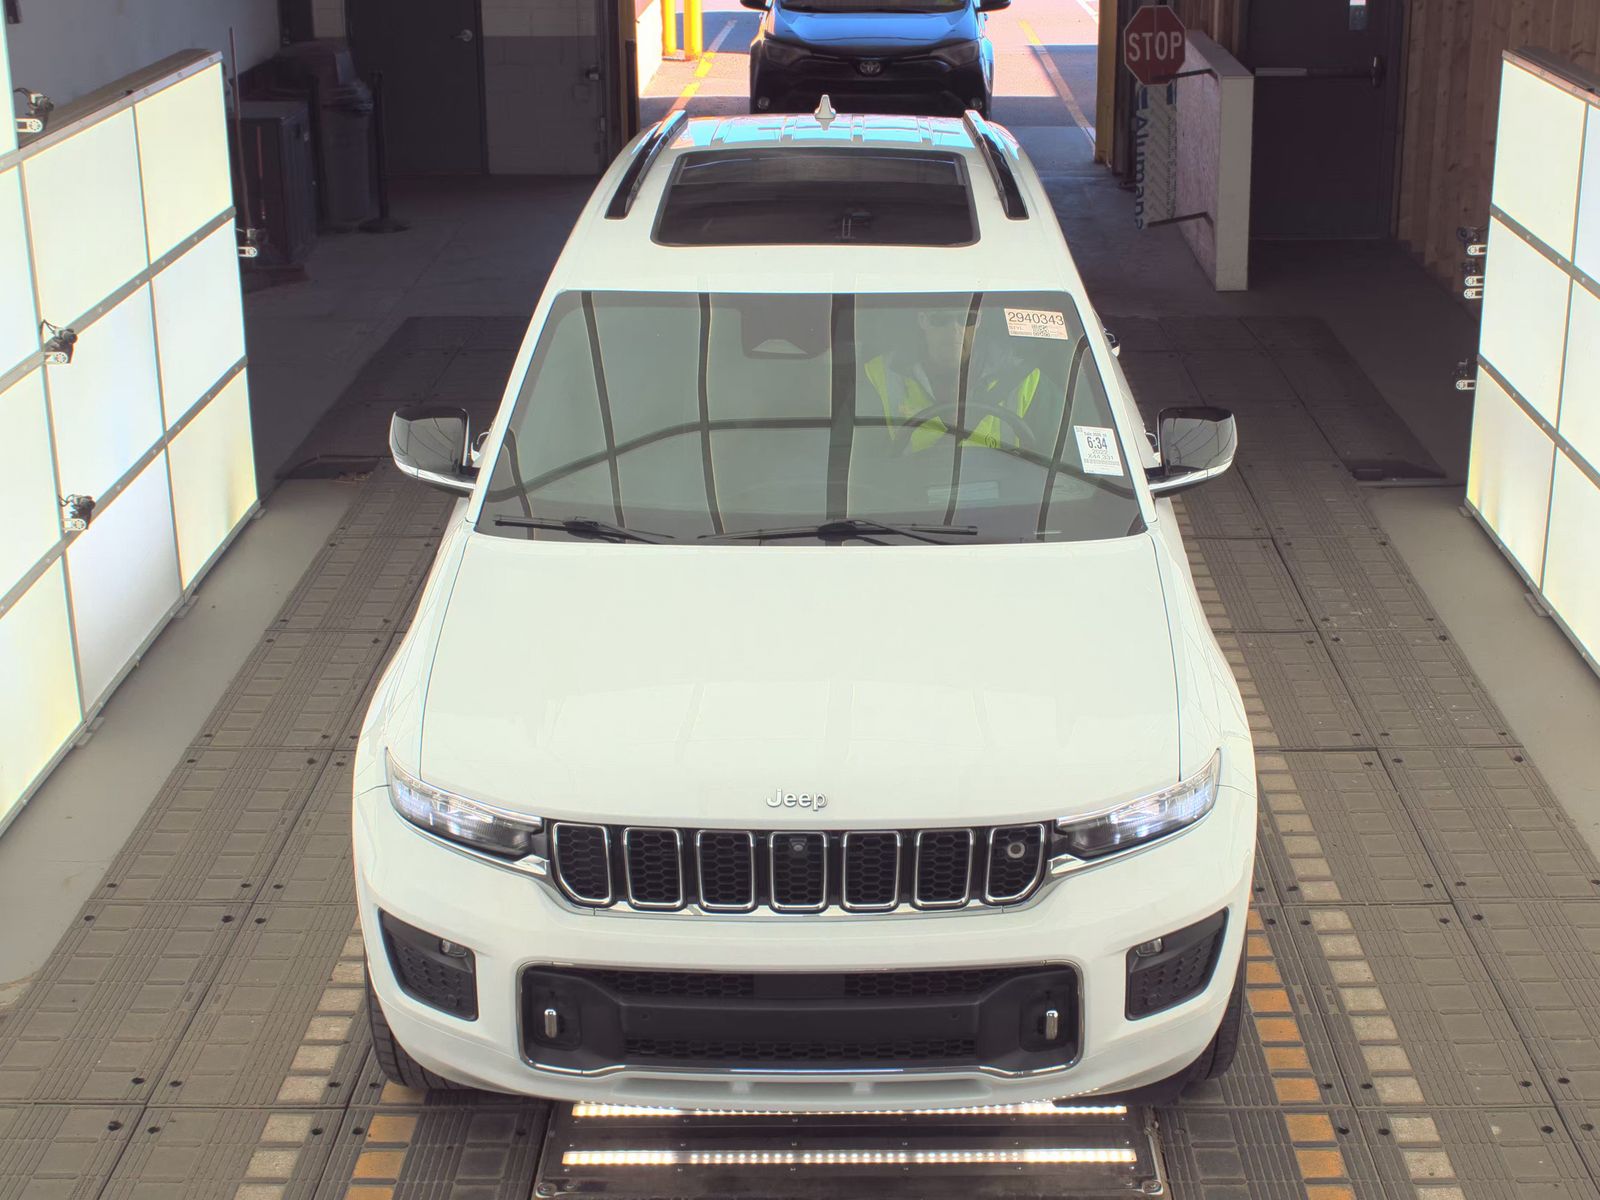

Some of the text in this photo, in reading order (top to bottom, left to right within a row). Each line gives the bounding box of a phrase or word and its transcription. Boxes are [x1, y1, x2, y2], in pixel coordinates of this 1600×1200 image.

[1128, 31, 1183, 62] STOP
[1008, 312, 1064, 326] 2940343
[1087, 436, 1107, 450] 6:34
[766, 788, 828, 812] Jeep
